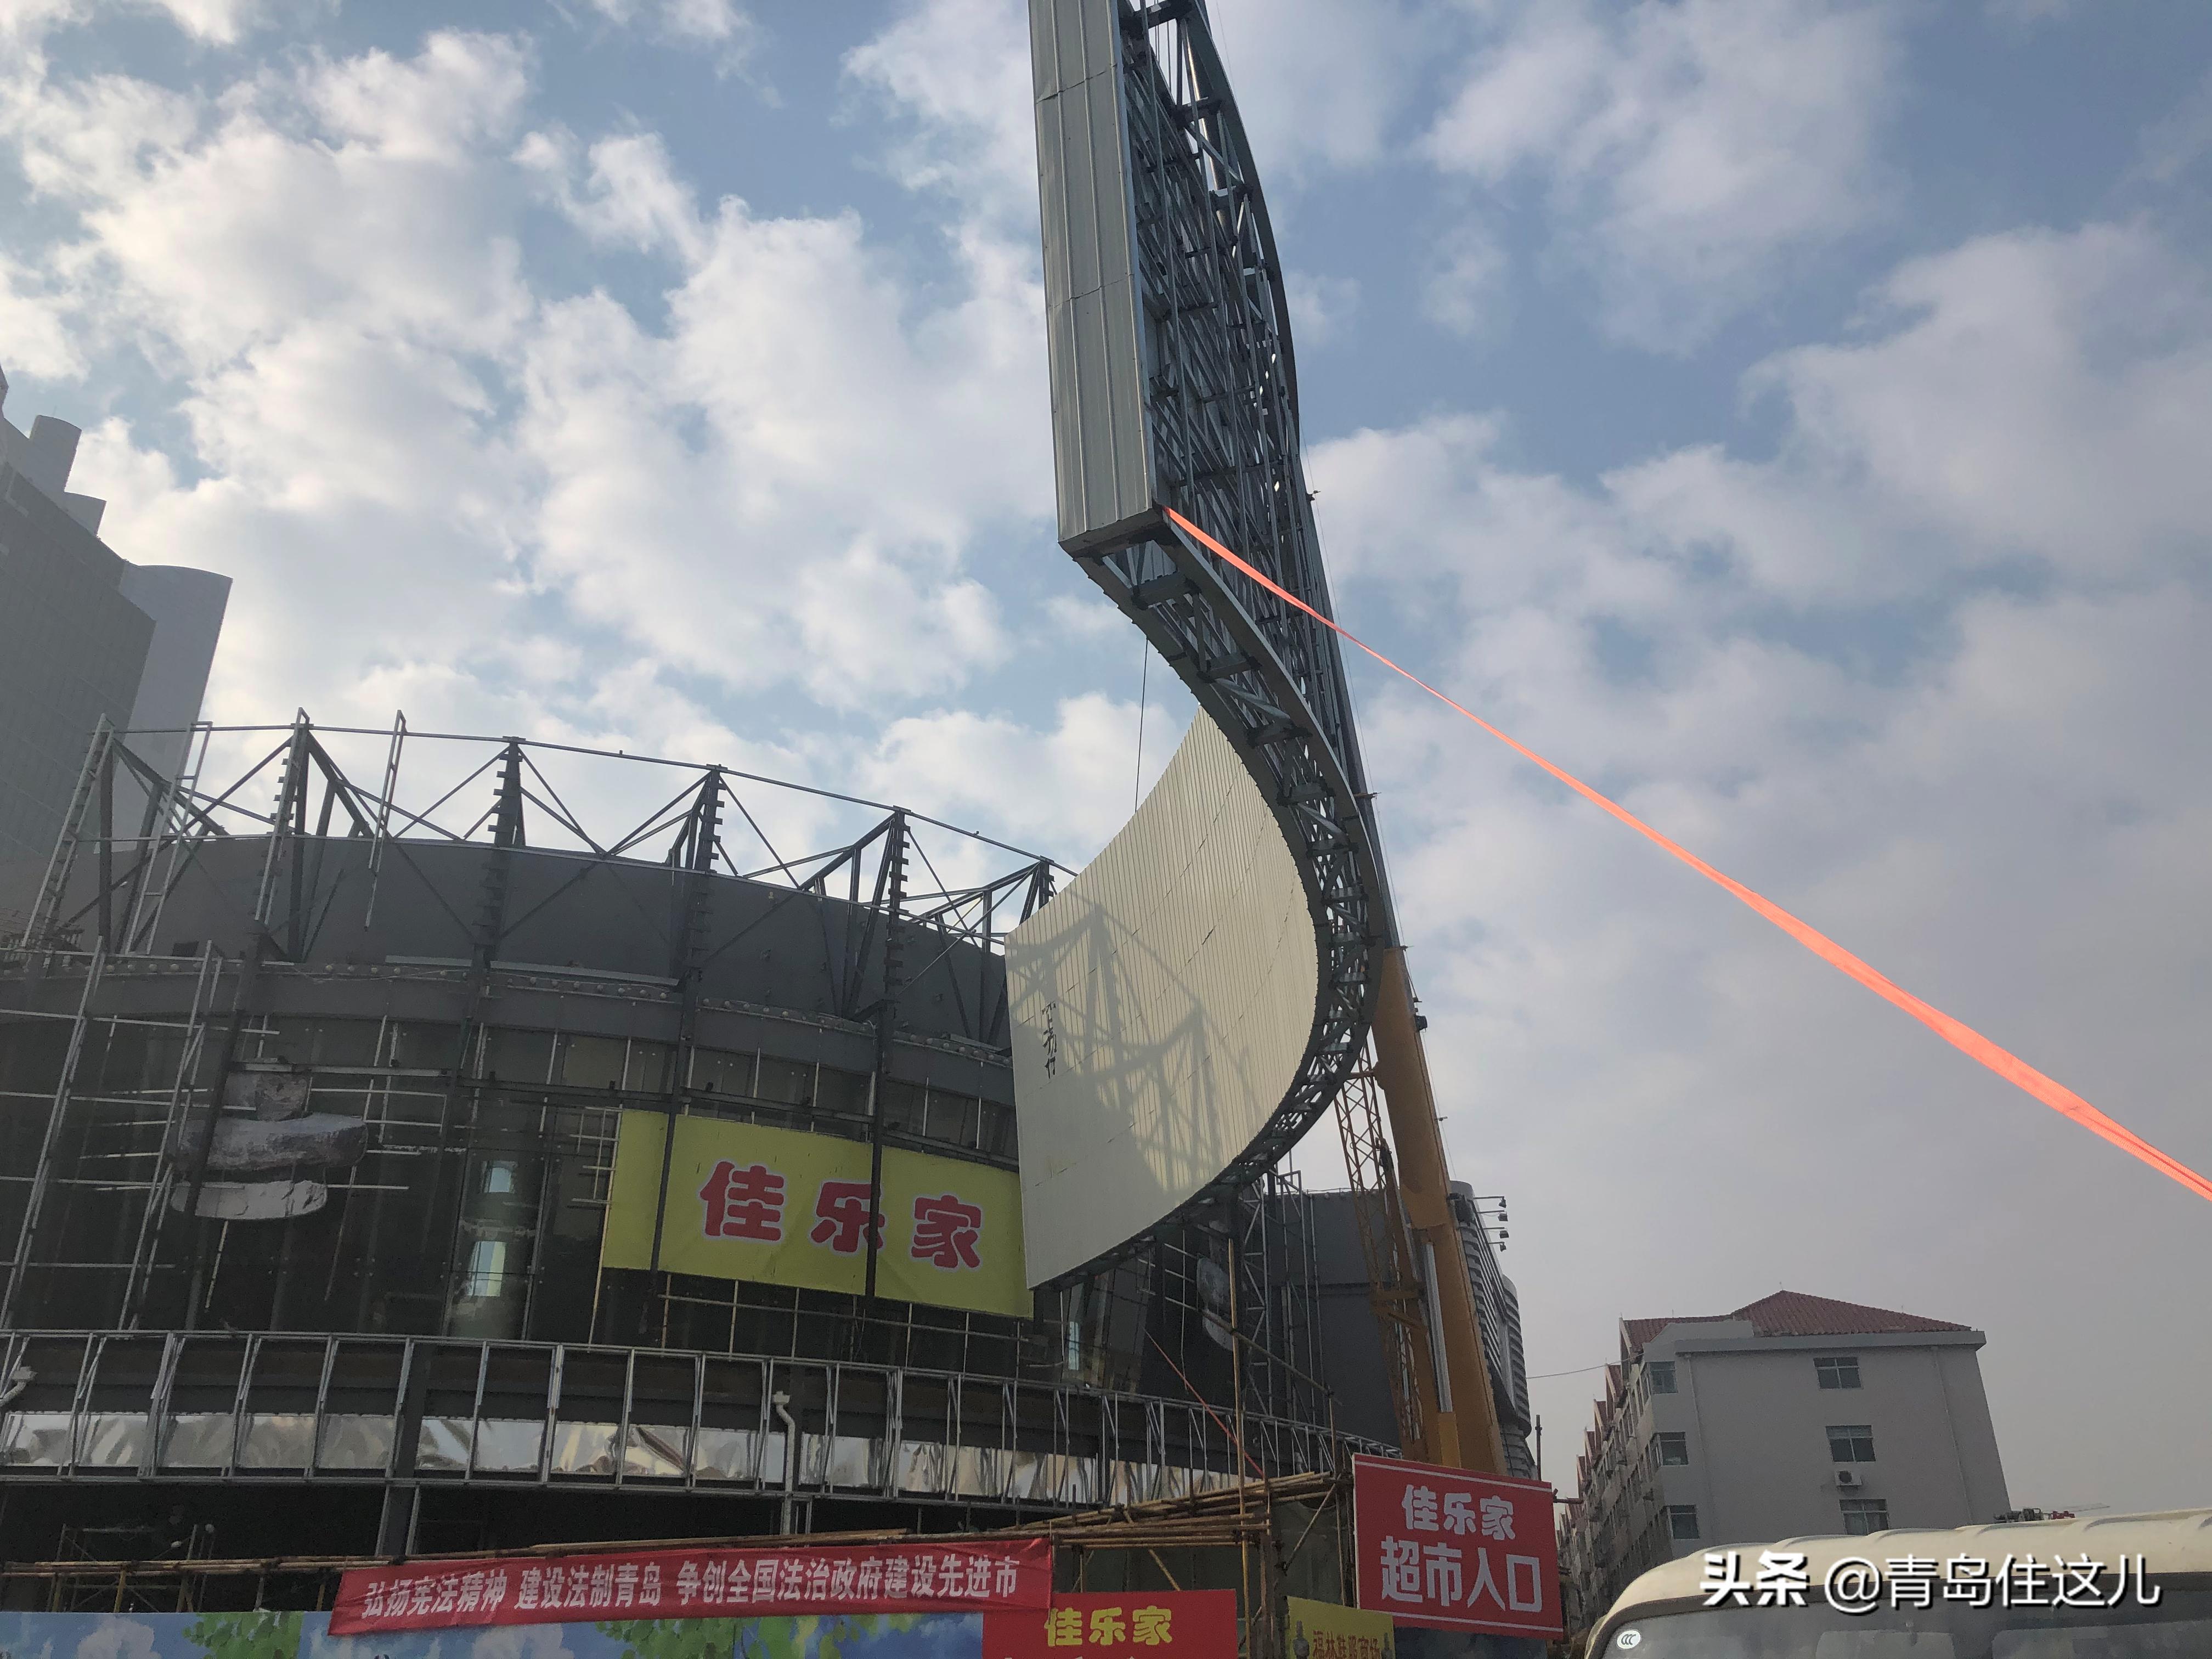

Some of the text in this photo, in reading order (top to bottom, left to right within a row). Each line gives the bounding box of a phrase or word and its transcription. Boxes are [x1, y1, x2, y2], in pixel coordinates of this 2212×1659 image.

[698, 1159, 984, 1269] 佳乐家
[1401, 1483, 1516, 1541] 佳乐家
[361, 1553, 1022, 1619] 弘扬宪法精神 建设法制青岛 争创全国法治政府建设先进市
[1043, 1605, 1173, 1646] 佳乐家
